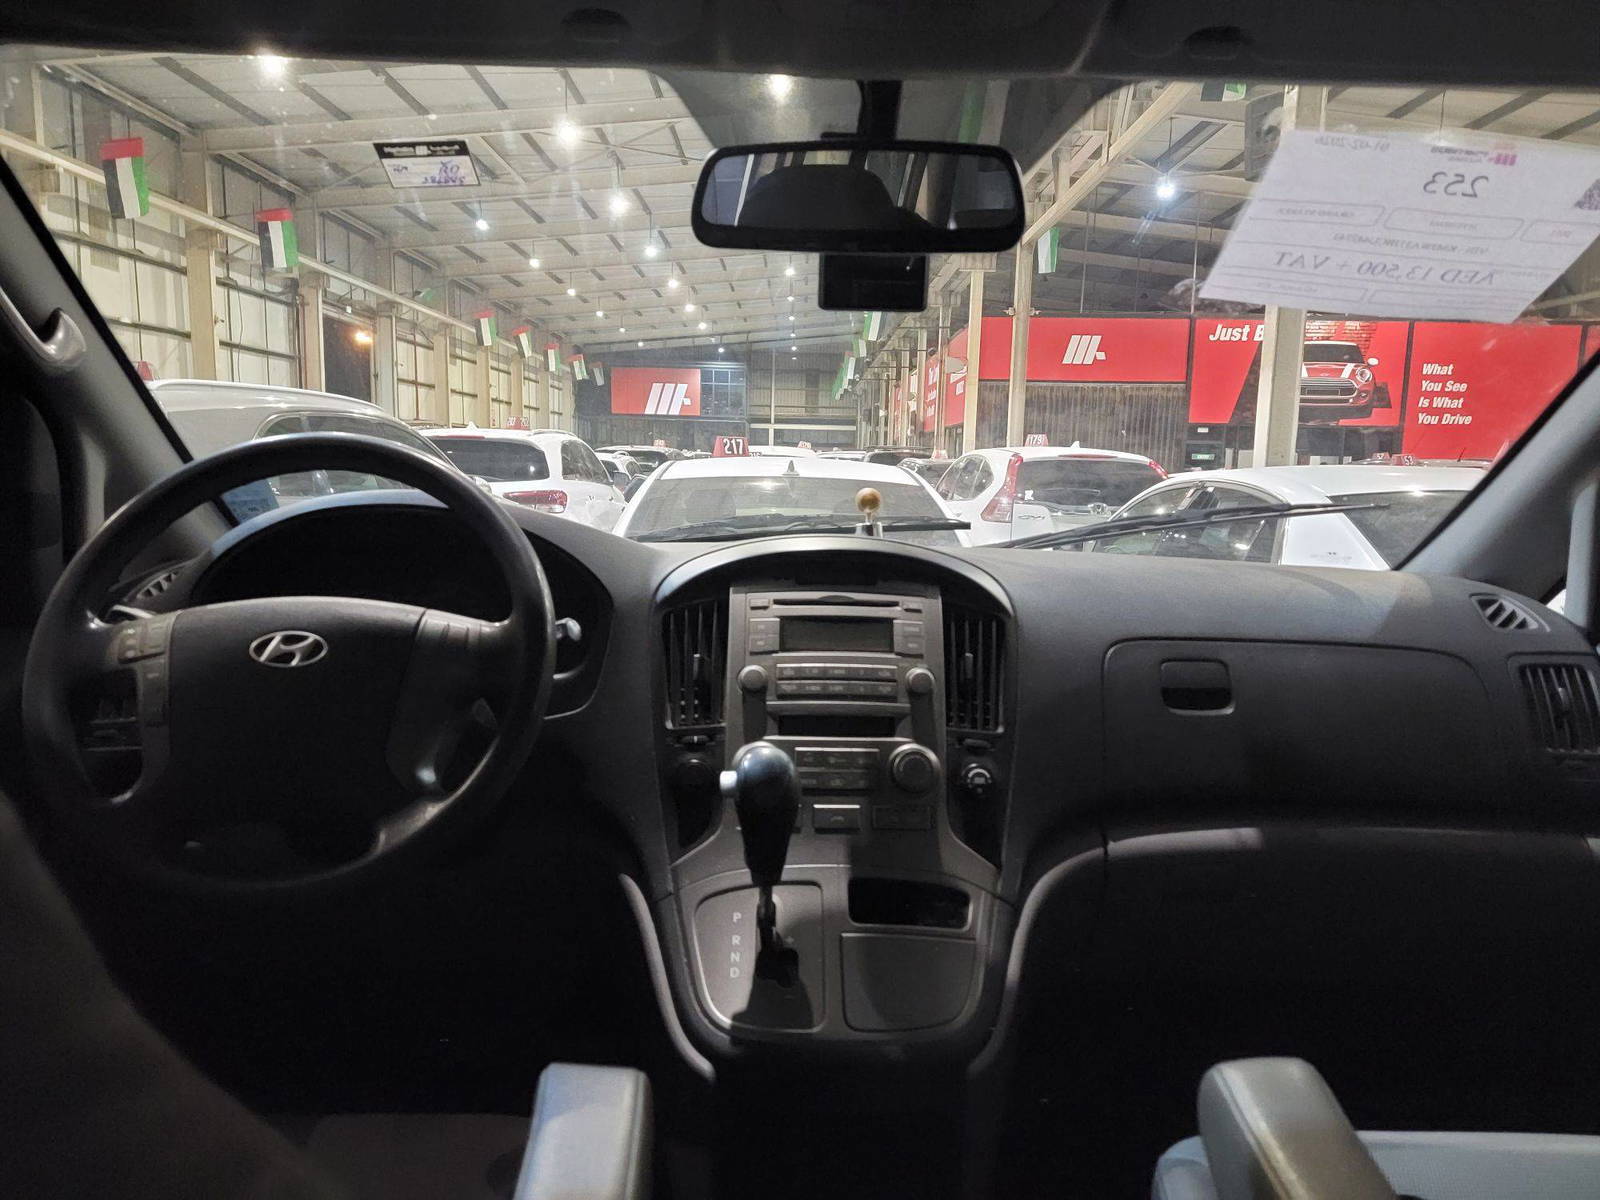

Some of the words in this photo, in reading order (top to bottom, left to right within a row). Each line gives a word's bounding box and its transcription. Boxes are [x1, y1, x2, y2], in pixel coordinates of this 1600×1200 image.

[1209, 323, 1249, 341] Just
[1422, 363, 1454, 376] What
[1421, 380, 1443, 393] You
[1444, 380, 1468, 393] See
[1418, 397, 1430, 409] Is
[1432, 396, 1464, 409] What
[1417, 412, 1440, 425] You
[1441, 413, 1472, 425] Drive
[723, 438, 743, 456] 217
[732, 911, 743, 923] P
[731, 935, 742, 946] R
[730, 951, 741, 963] N
[729, 967, 740, 979] D
